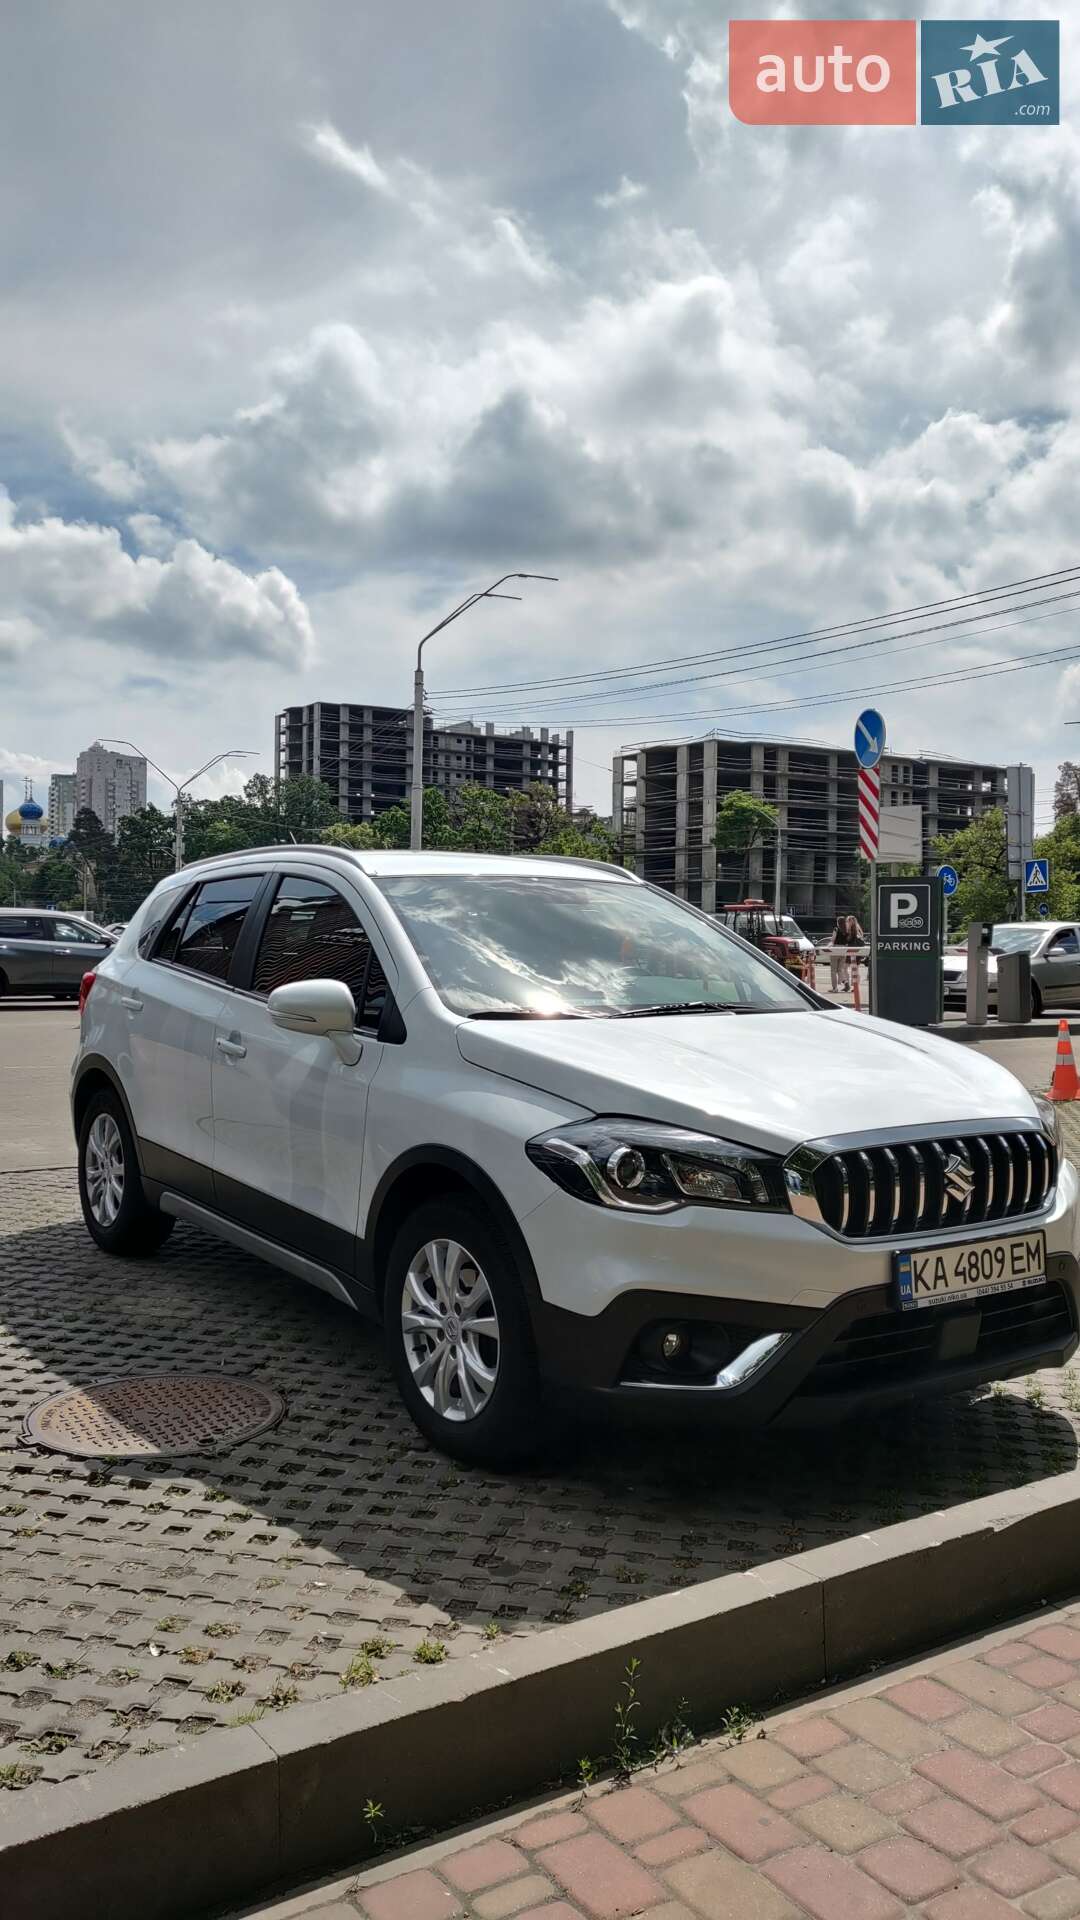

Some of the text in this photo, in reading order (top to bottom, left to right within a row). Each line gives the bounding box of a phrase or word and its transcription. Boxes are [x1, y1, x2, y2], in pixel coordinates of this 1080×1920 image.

[890, 893, 918, 928] P
[877, 942, 930, 951] PARKING
[913, 1239, 1041, 1293] KA 4809 EM
[900, 1285, 912, 1296] UA
